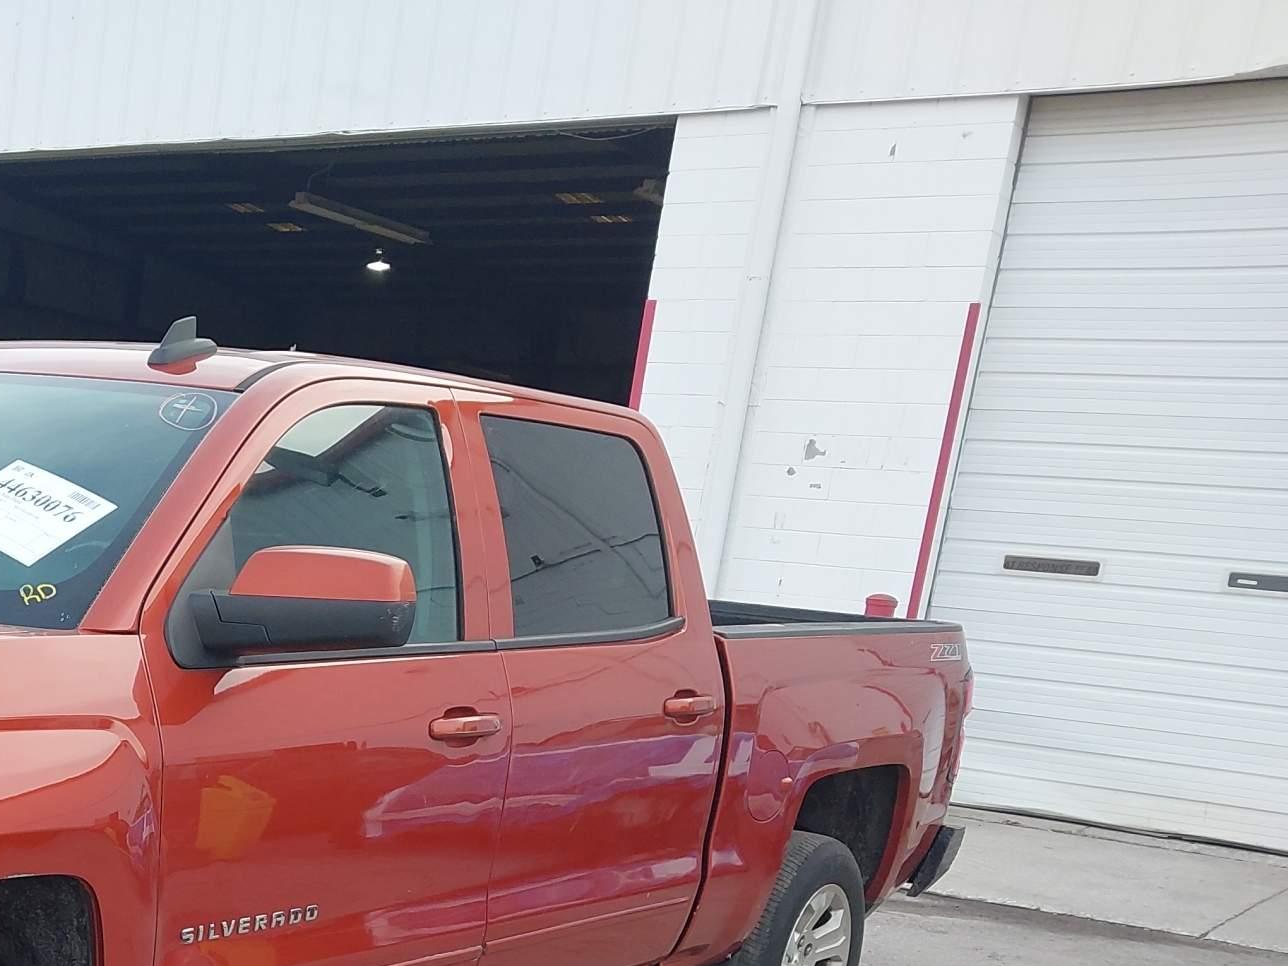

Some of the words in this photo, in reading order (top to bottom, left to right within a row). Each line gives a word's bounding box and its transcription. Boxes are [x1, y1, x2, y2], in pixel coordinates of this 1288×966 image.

[19, 583, 57, 606] RD
[930, 643, 961, 662] Z71
[180, 904, 319, 945] SILVERADO
